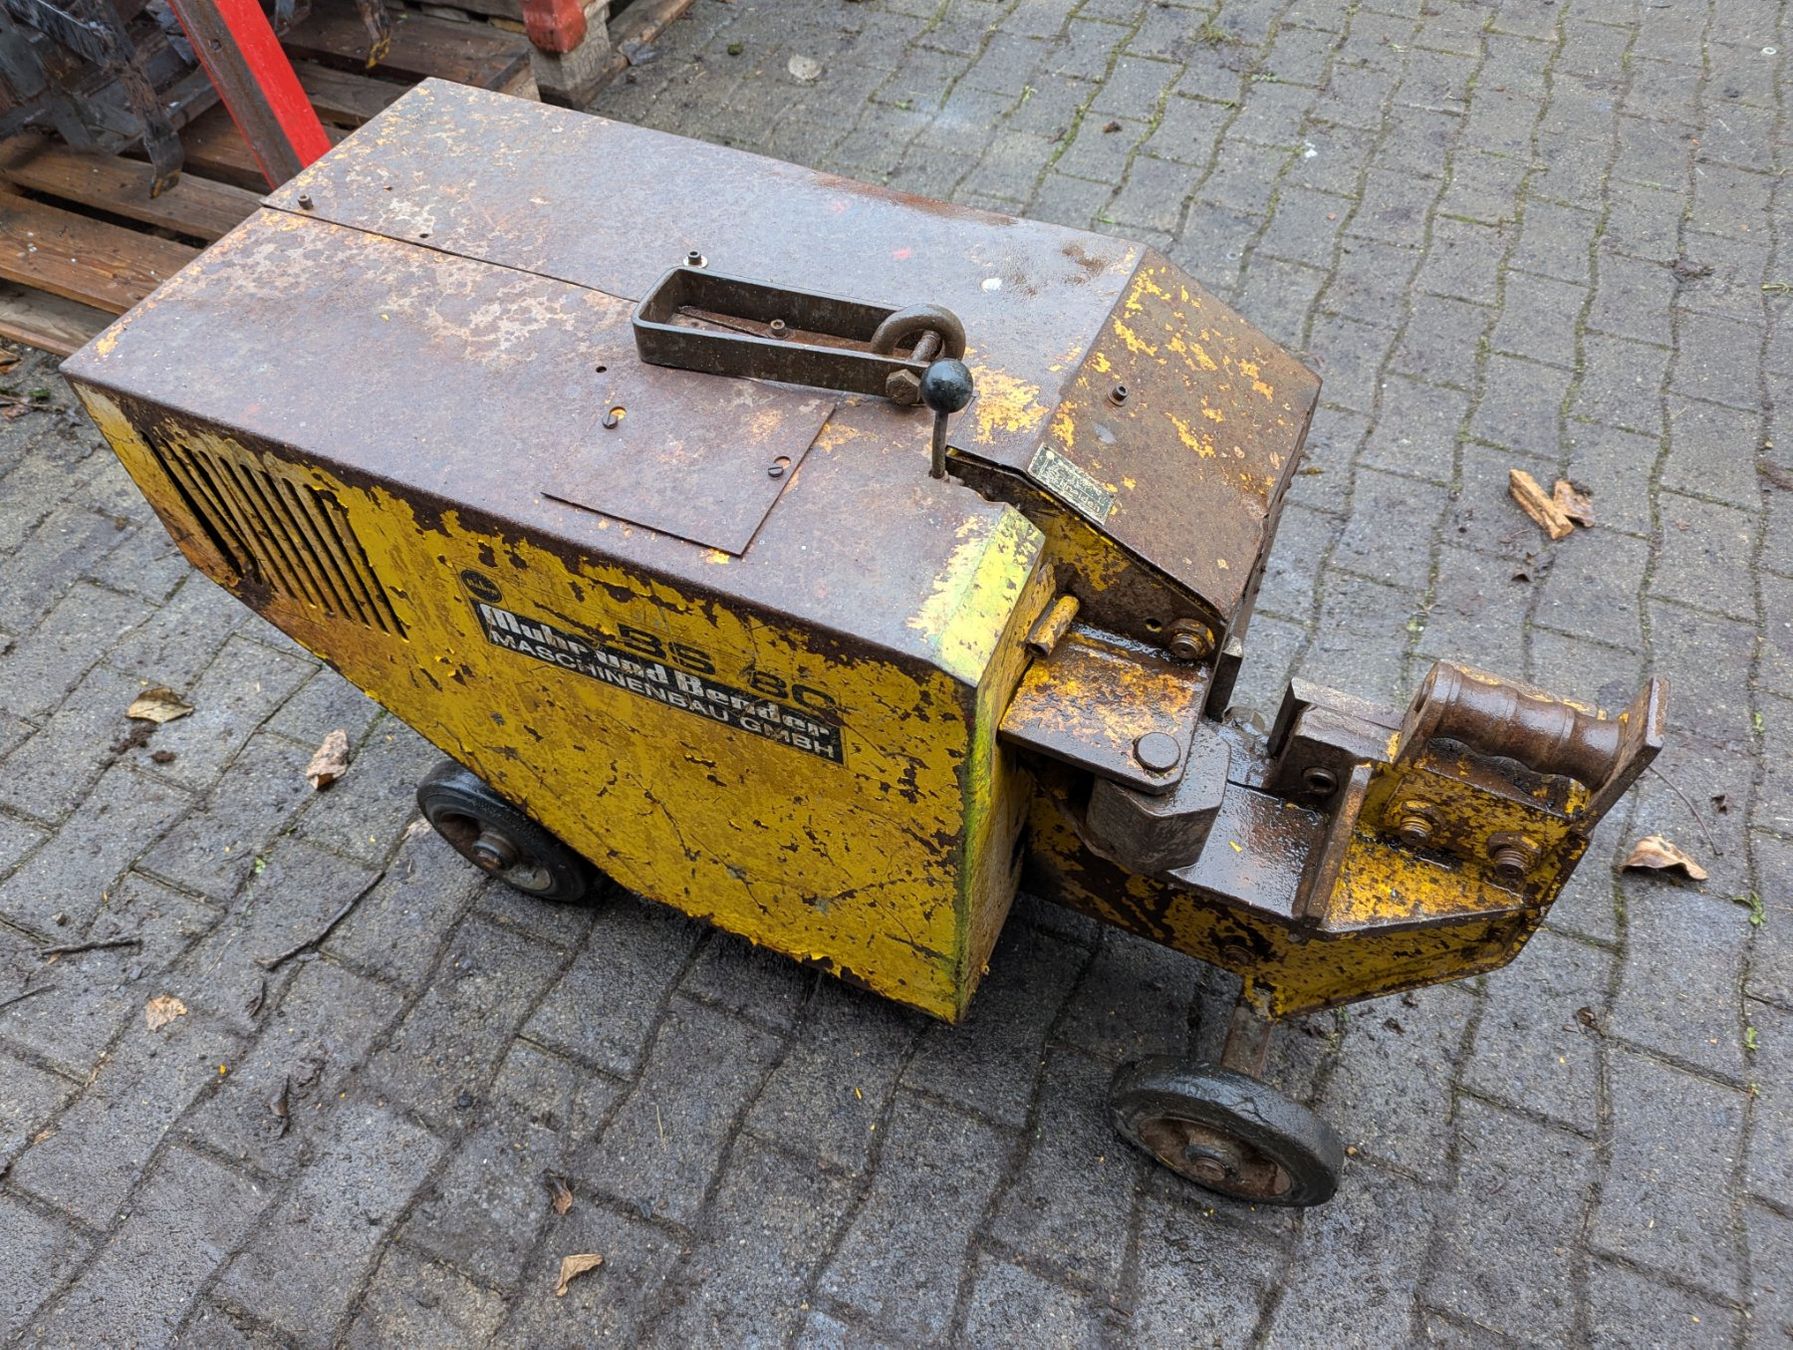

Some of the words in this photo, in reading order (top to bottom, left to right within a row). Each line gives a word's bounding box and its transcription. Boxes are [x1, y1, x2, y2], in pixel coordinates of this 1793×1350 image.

[479, 603, 589, 655] Muhr
[596, 651, 670, 684] und
[675, 671, 831, 738] Bender
[490, 631, 729, 721] MASCHINENBAU
[740, 716, 834, 759] GMBH
[617, 623, 716, 674] BS
[749, 669, 838, 716] 80
